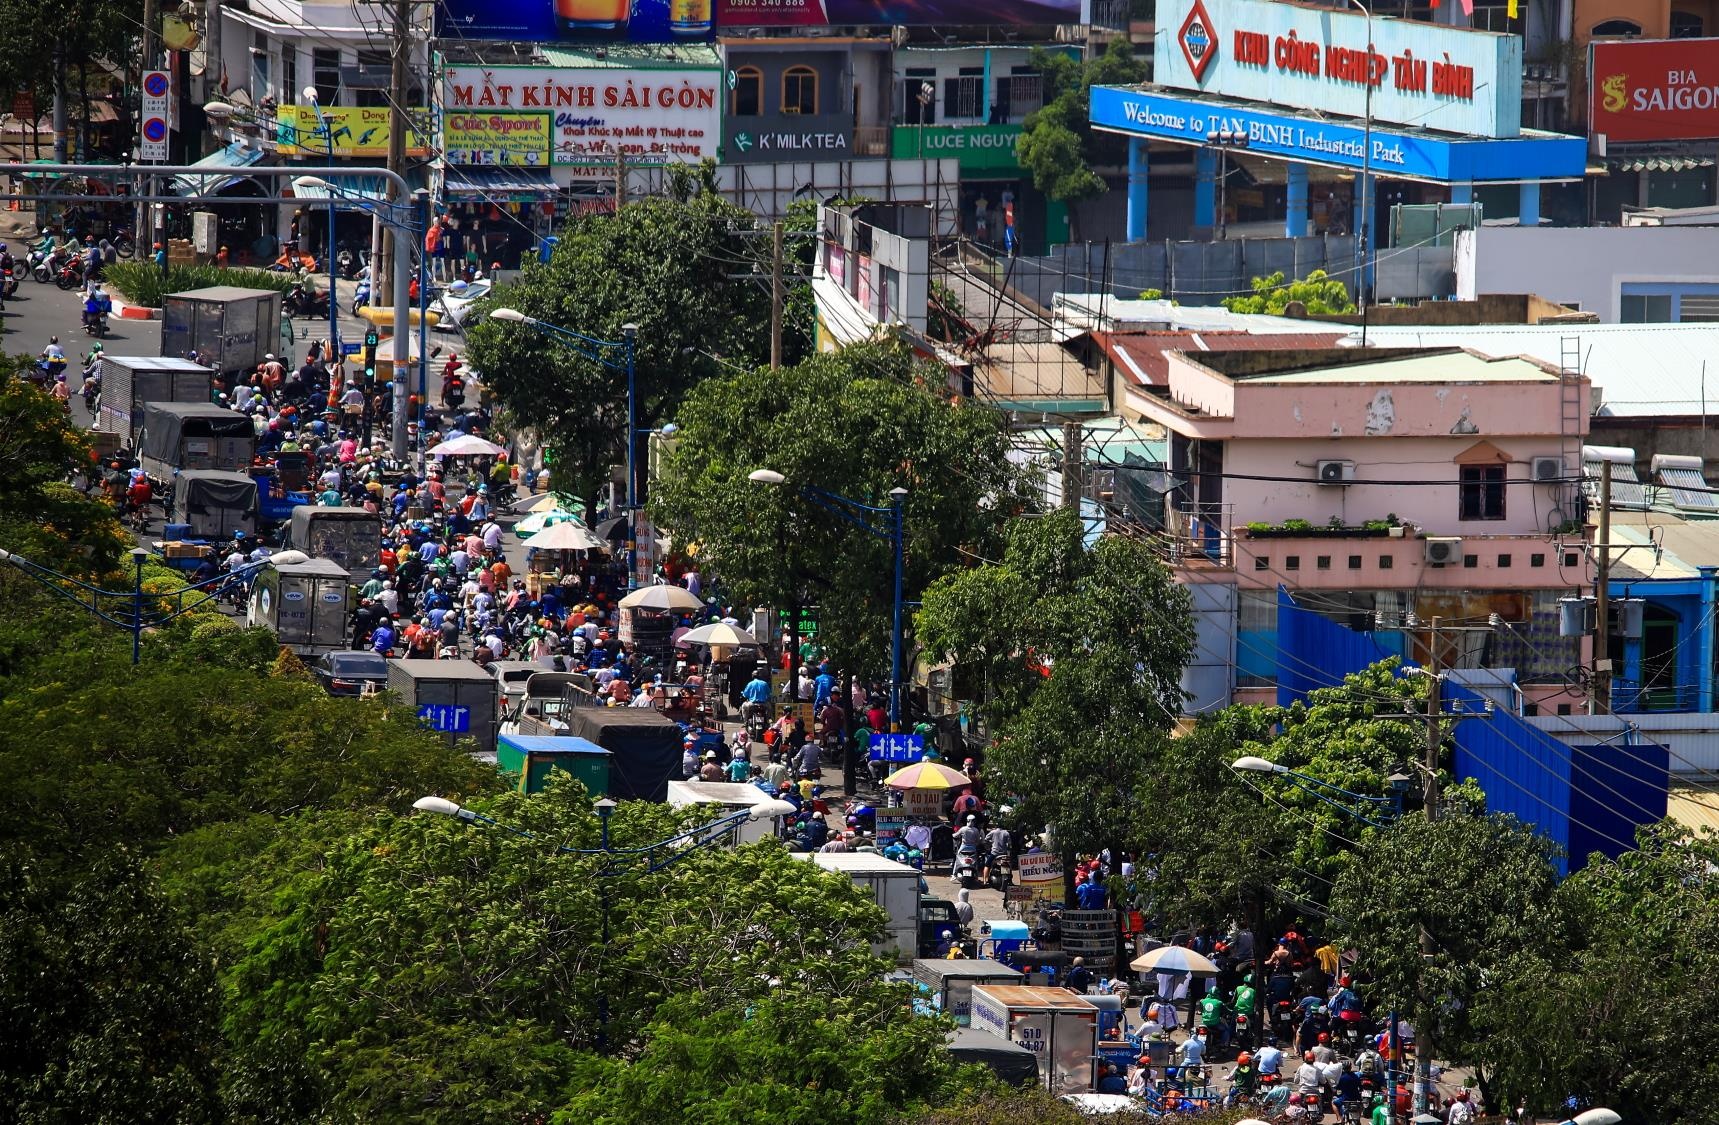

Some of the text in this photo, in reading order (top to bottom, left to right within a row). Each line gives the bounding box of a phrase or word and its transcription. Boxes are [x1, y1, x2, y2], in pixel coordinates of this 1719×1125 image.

[1233, 30, 1269, 67] KHU
[1274, 29, 1320, 77] CÔNG
[1392, 49, 1427, 93] TÂN
[1432, 52, 1473, 99] BÌNH
[1668, 69, 1698, 85] BIA
[523, 79, 594, 107] KÍNH
[604, 80, 650, 108] SÀI
[657, 80, 715, 109] GÒN
[1633, 86, 1719, 111] SAIGO
[488, 115, 542, 134] Sport
[588, 127, 610, 136] Khúc
[625, 125, 644, 136] Mắt
[660, 127, 685, 138] Thuật
[688, 130, 704, 138] cao
[1122, 102, 1185, 131] Welcome
[1189, 116, 1203, 132] to
[1249, 120, 1294, 147] BINH
[1298, 127, 1366, 158] Industria
[1372, 140, 1405, 164] Park
[816, 133, 846, 148] TEA
[926, 135, 965, 149] LUCE
[367, 335, 376, 345] 23
